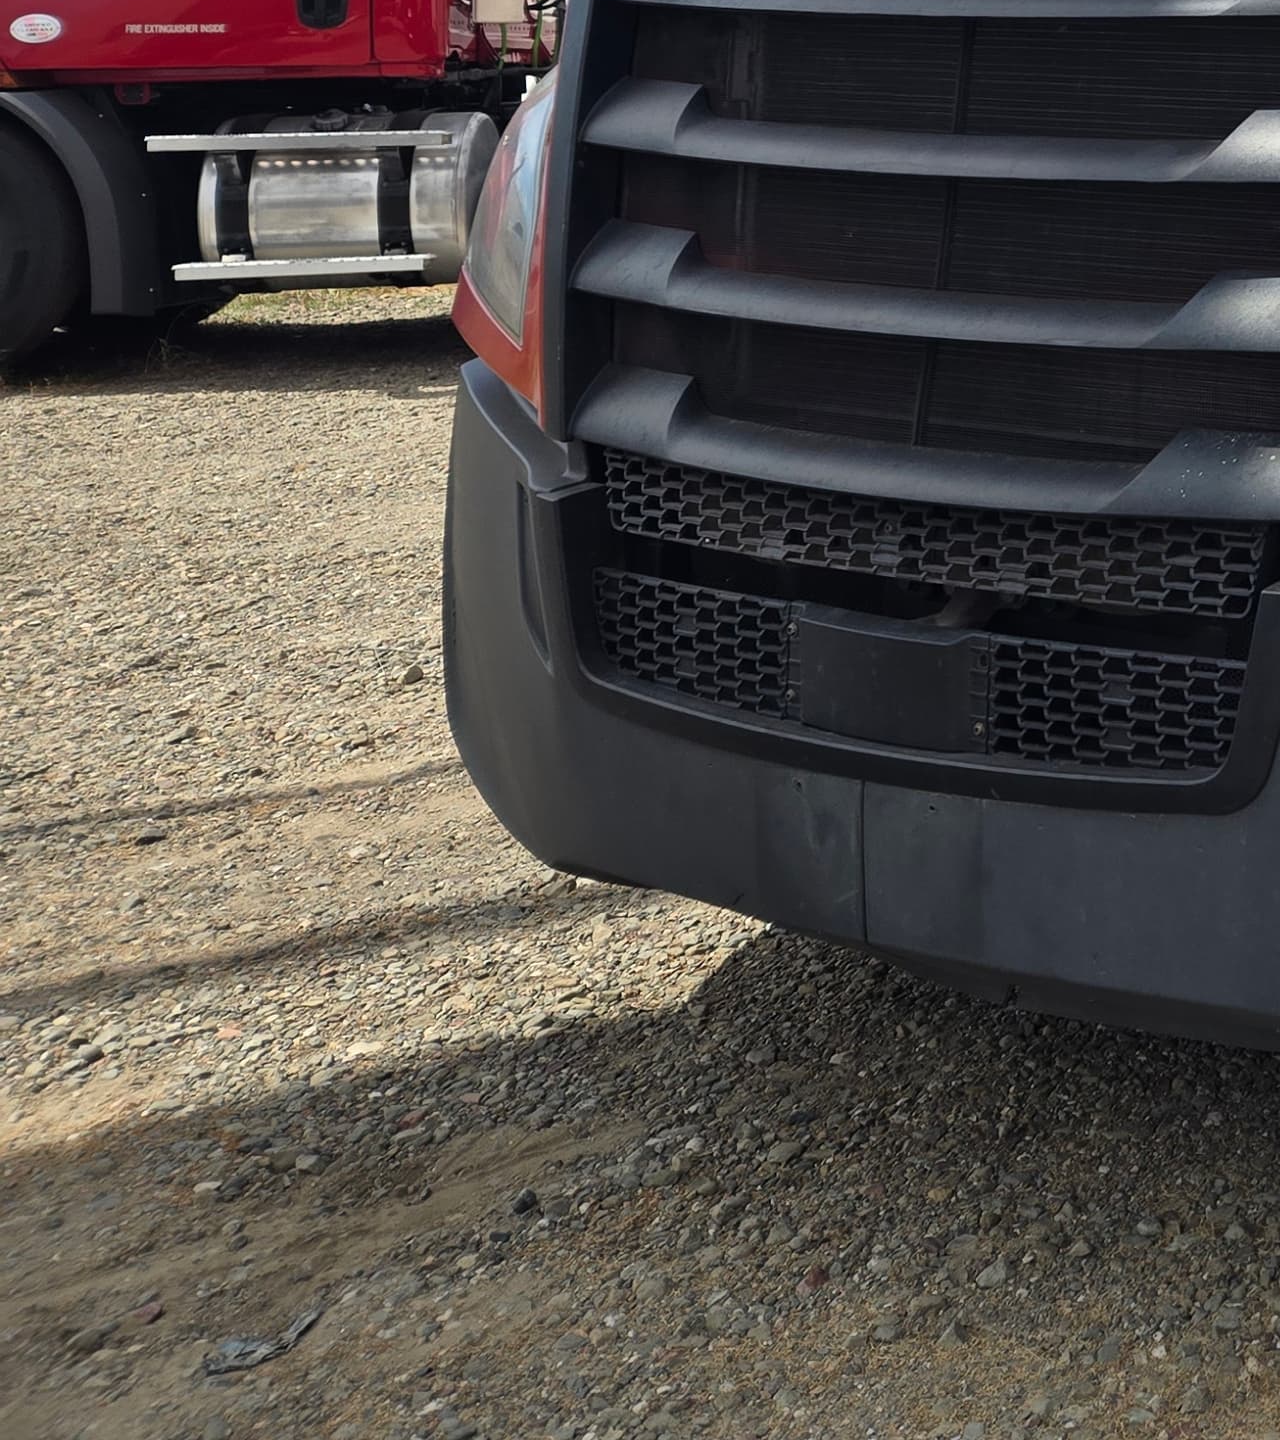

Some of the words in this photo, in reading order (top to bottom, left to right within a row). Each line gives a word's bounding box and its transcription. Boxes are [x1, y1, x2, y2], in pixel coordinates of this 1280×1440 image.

[125, 24, 142, 34] FIRE
[144, 24, 198, 34] EXTINGUISHER
[200, 24, 225, 34] INSIDE
